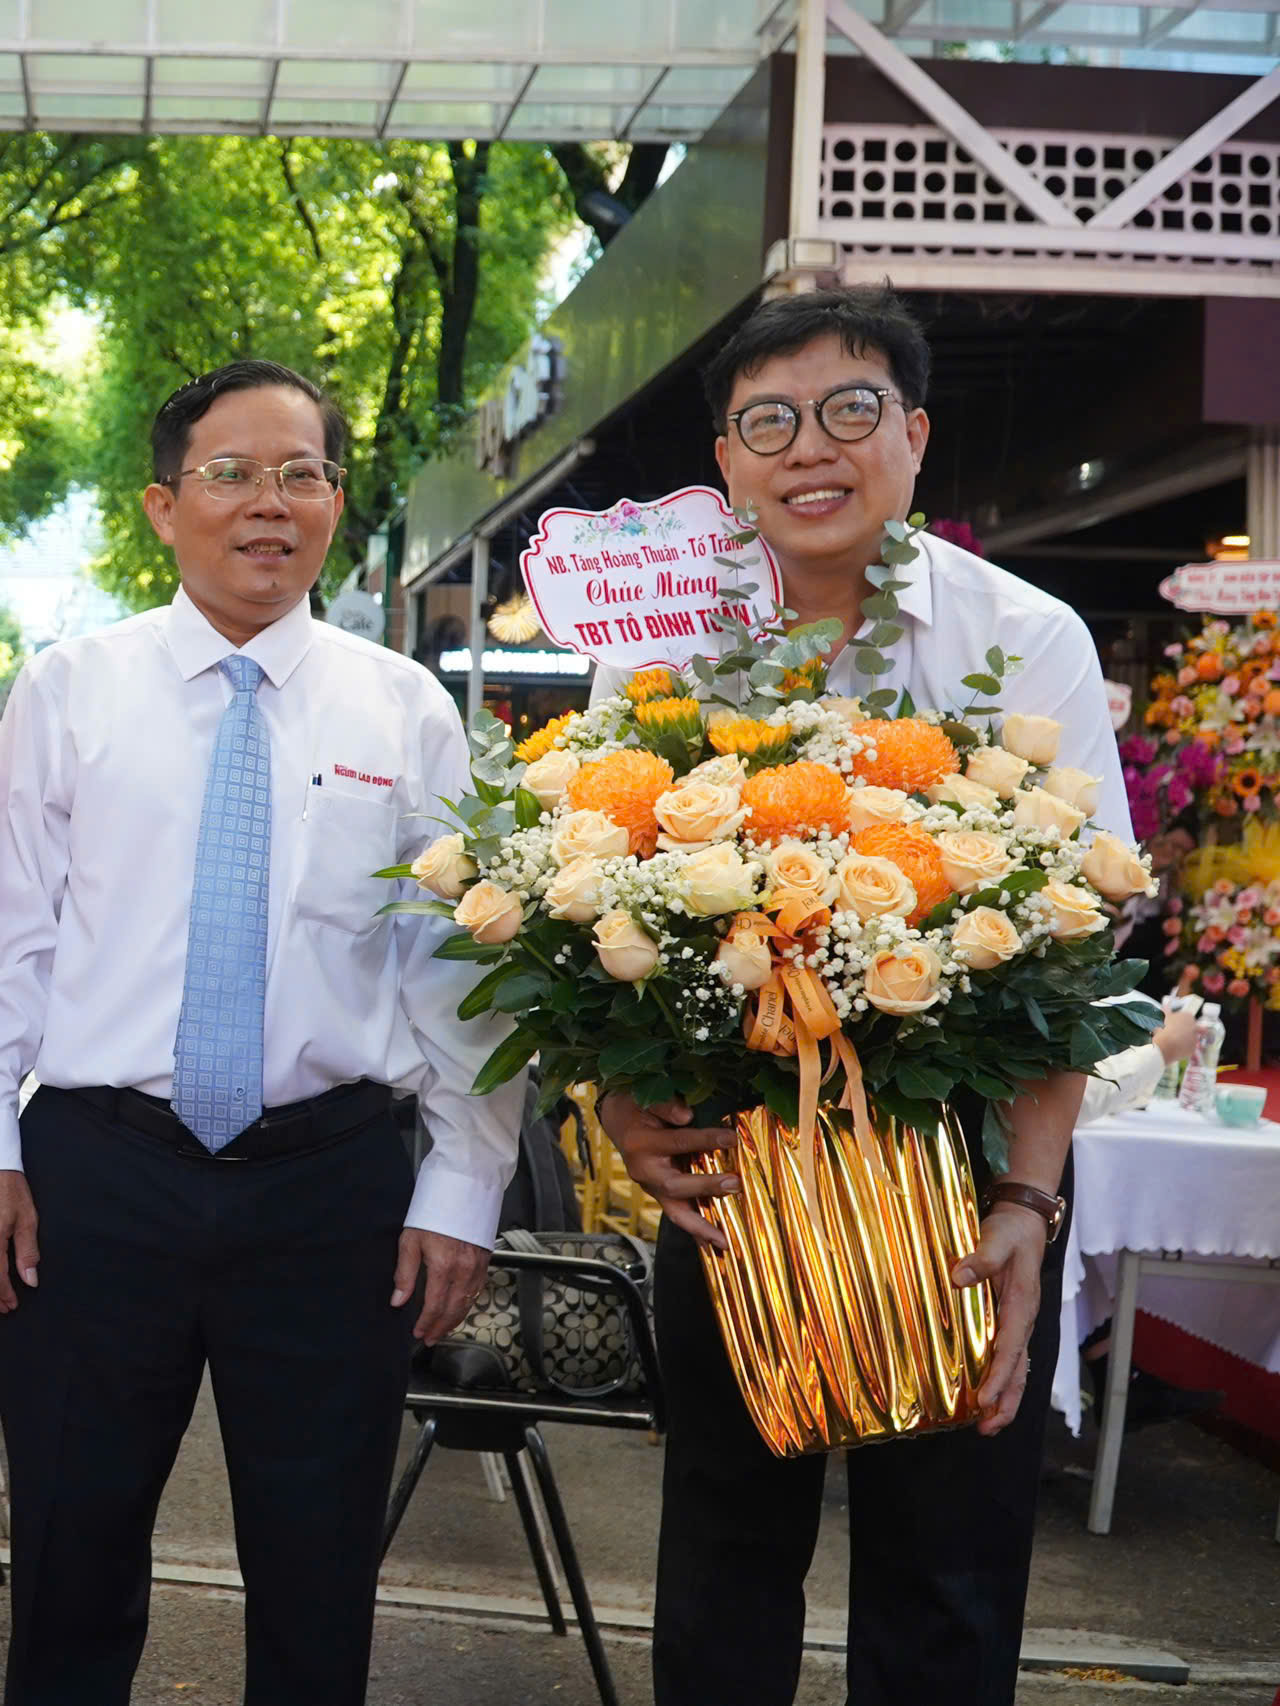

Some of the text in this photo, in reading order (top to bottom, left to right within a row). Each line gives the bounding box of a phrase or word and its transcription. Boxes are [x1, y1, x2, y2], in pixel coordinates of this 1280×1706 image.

[546, 556, 571, 575] NB.
[640, 544, 680, 566] Thuận
[688, 534, 706, 558] Tố
[586, 571, 719, 606] Chúc Mừng
[574, 620, 613, 647] TBT
[614, 612, 643, 643] TÔ
[644, 609, 696, 640] ĐÌNH
